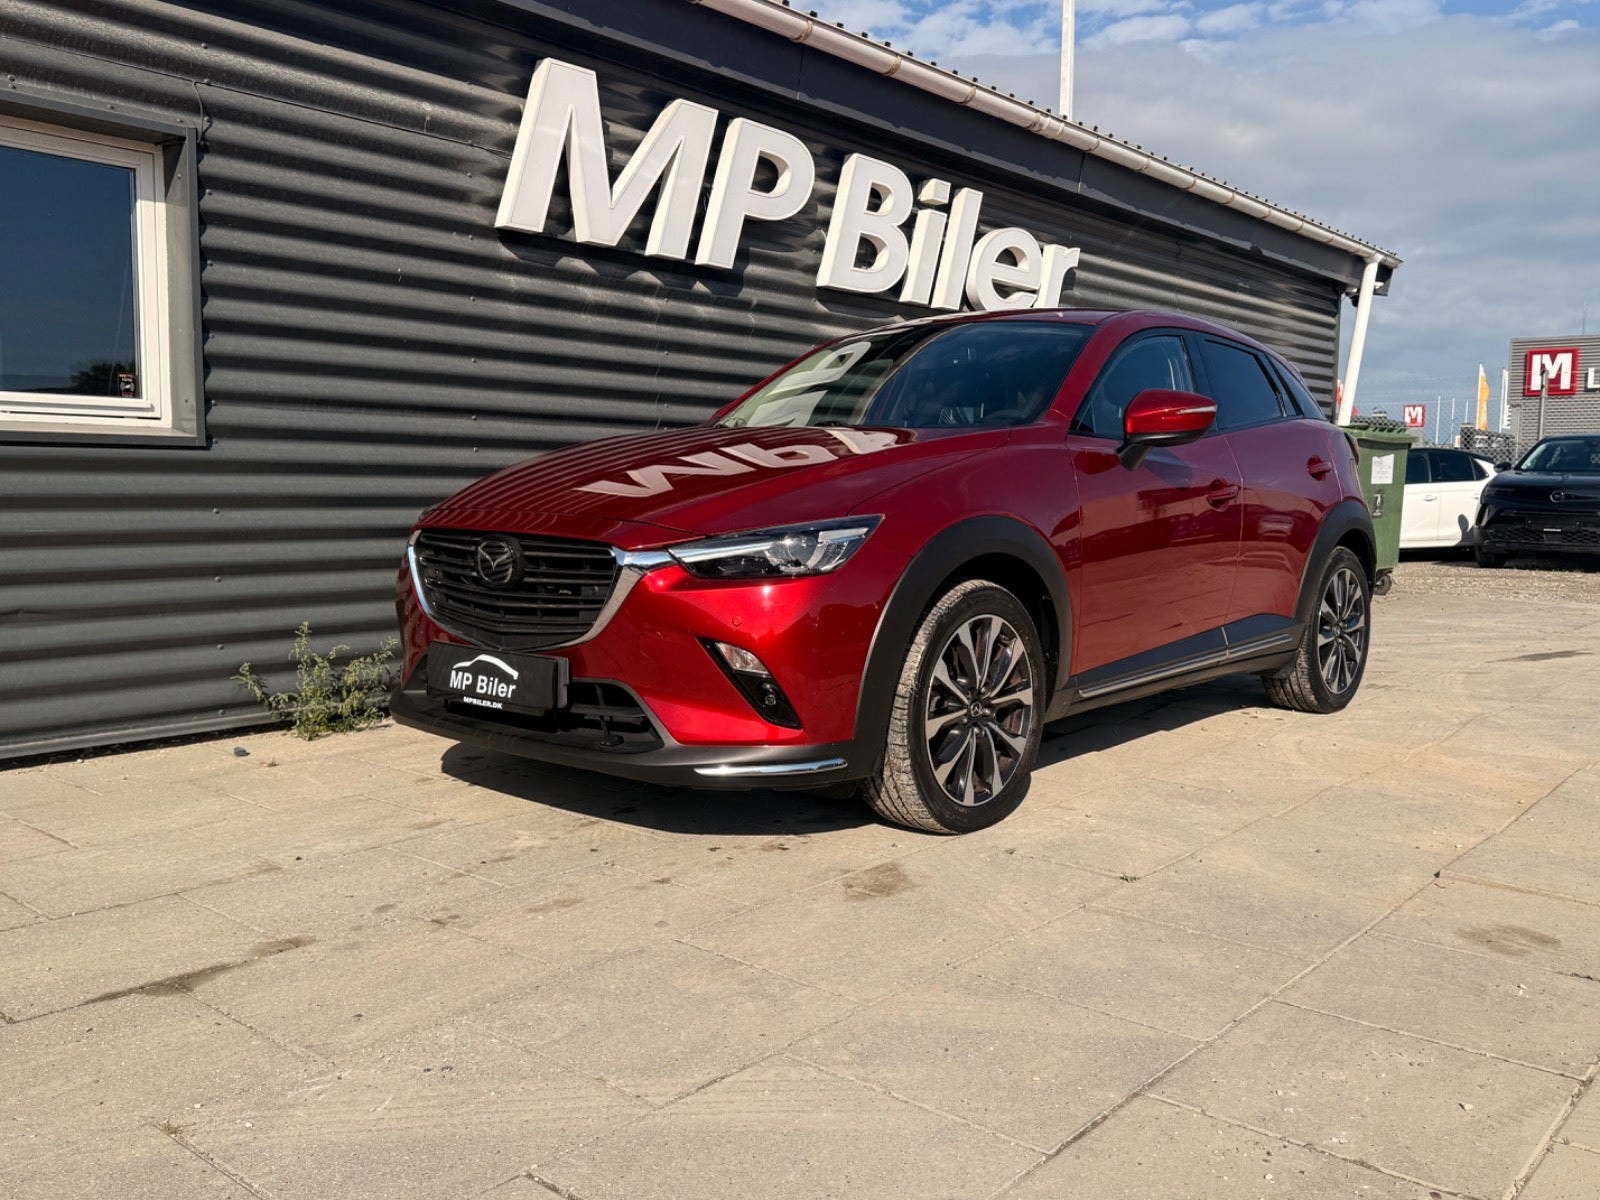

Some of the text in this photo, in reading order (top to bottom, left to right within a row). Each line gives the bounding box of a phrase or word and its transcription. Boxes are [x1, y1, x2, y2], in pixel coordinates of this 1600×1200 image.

[495, 57, 1080, 311] MP Biler
[1530, 353, 1573, 391] M
[451, 670, 516, 698] MP Biler
